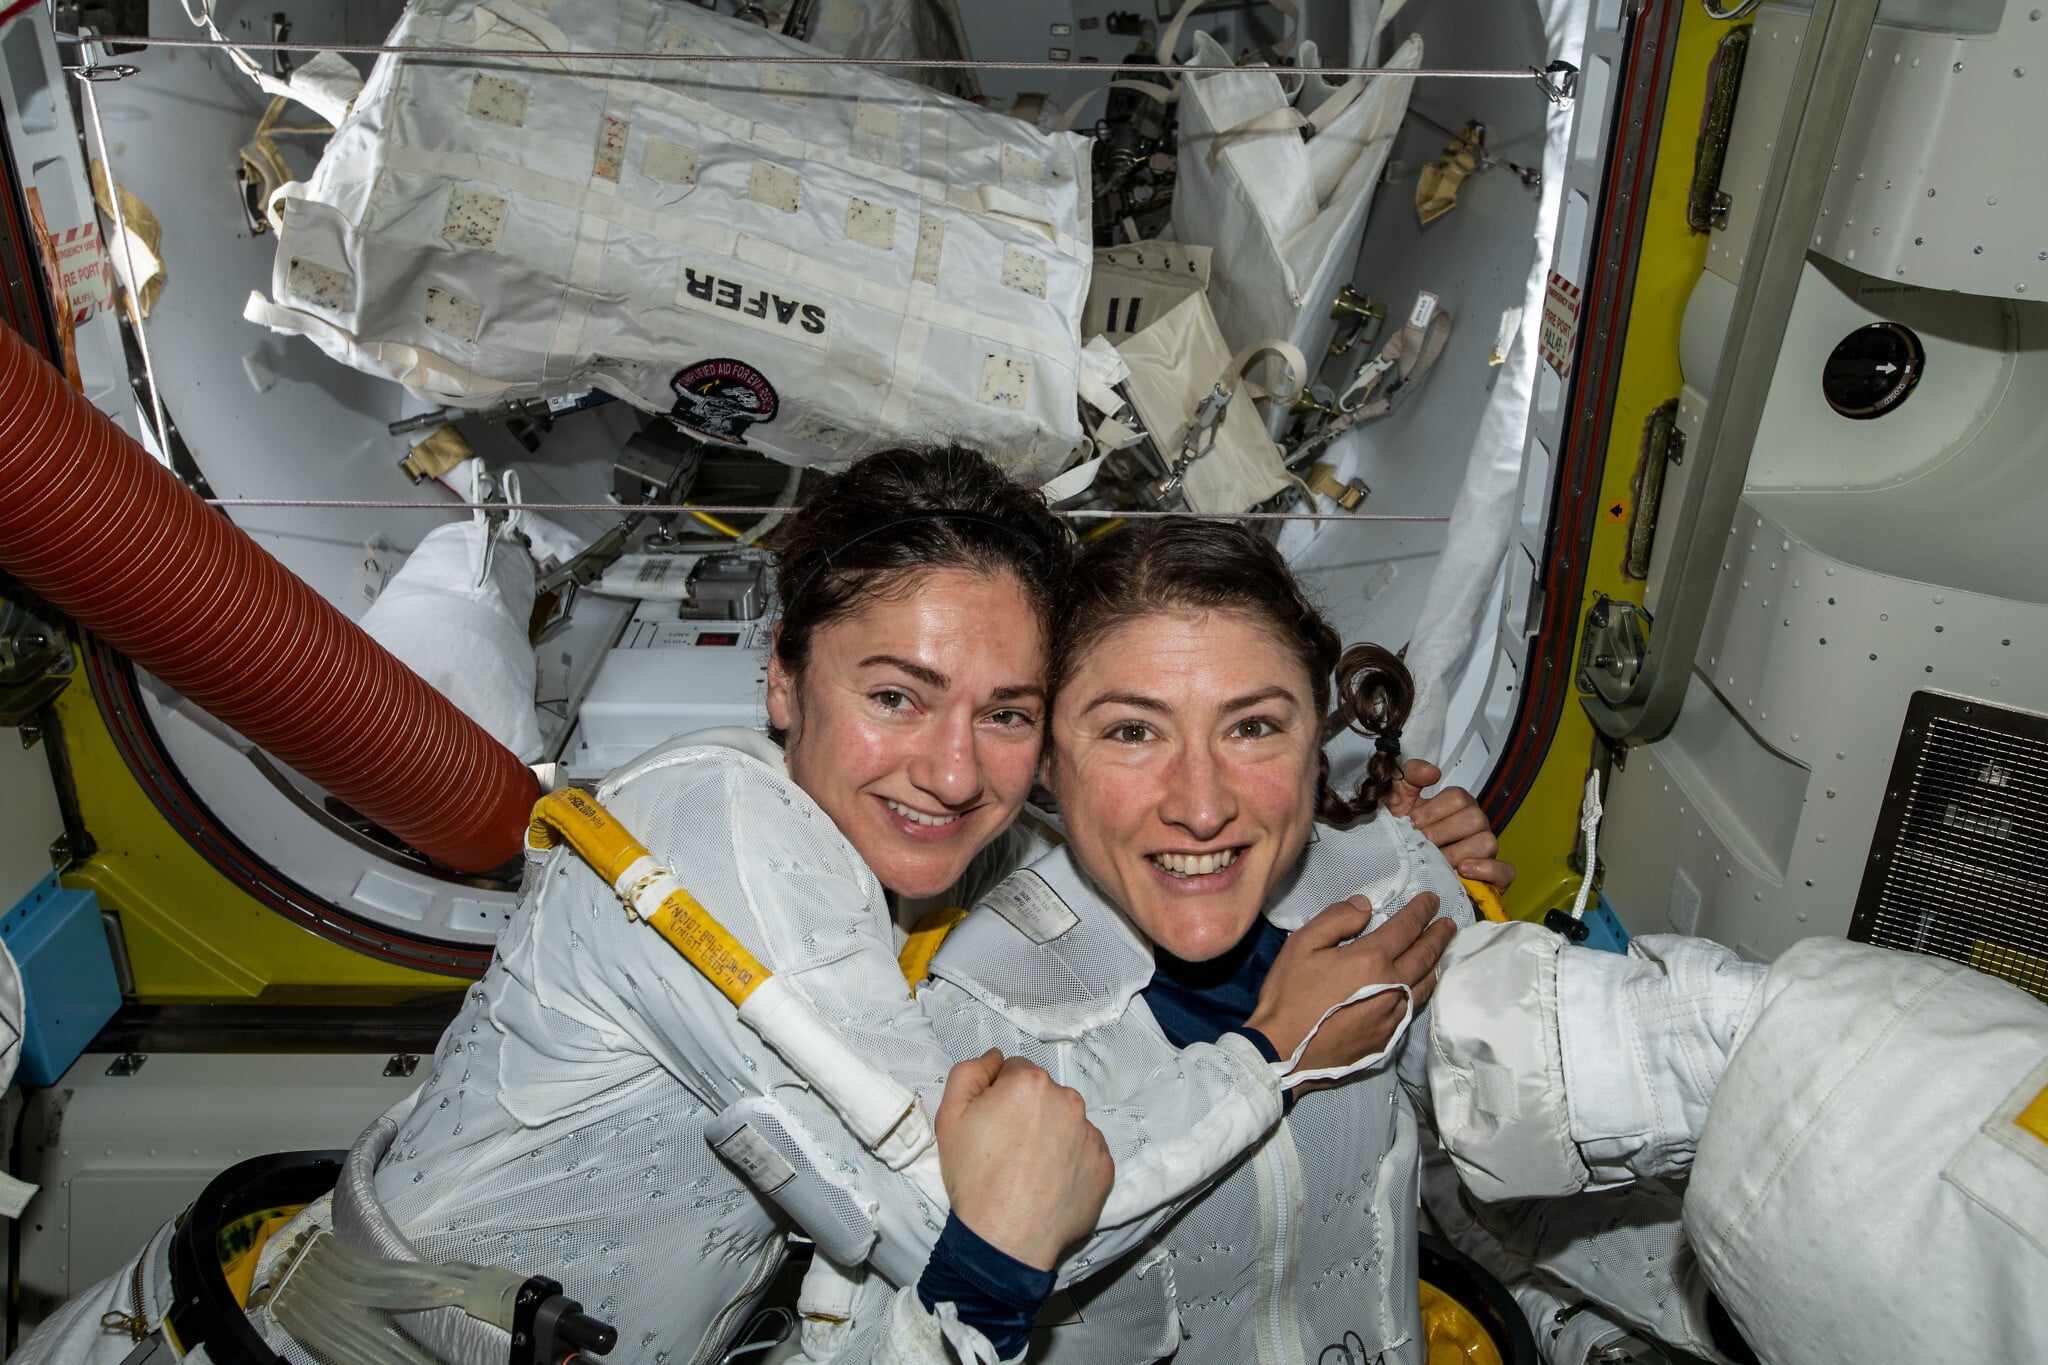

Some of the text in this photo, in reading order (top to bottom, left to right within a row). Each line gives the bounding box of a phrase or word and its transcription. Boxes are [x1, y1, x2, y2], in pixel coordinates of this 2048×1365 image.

[77, 262, 100, 281] PORT
[685, 267, 826, 335] SAFER
[1545, 308, 1572, 337] FIRE PORT
[718, 363, 731, 375] AID
[732, 366, 750, 381] FOR
[1884, 383, 1906, 405] CLOSED
